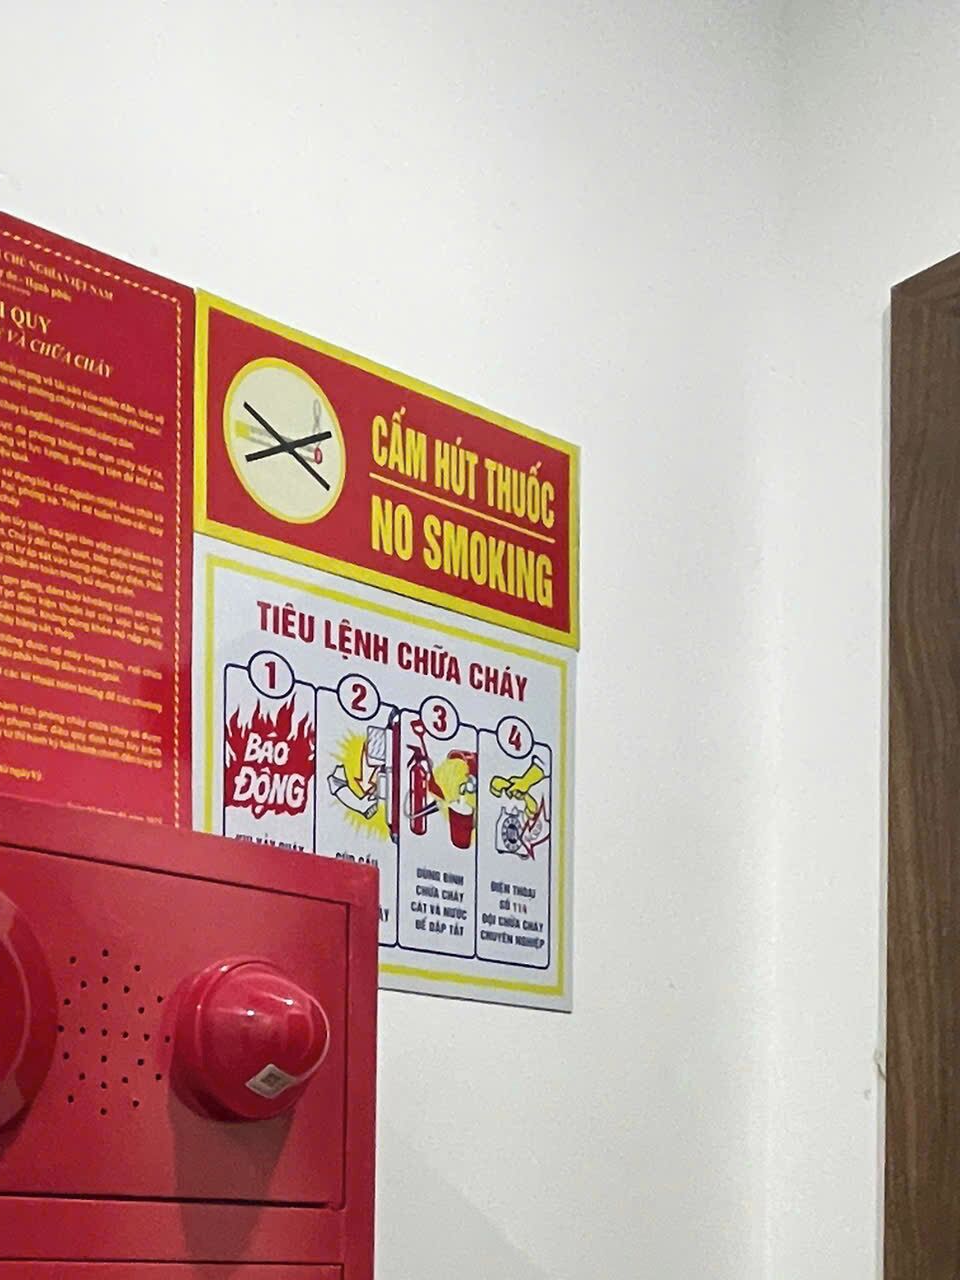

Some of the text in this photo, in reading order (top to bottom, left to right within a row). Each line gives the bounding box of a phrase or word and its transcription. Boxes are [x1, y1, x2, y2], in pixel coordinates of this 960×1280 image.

[10, 306, 51, 333] QUY
[7, 326, 25, 347] VÀ
[29, 339, 71, 363] CHỮA
[74, 354, 110, 377] CHÁY
[372, 406, 555, 528] CẤM HÚT THUỐC
[371, 495, 553, 608] NO SMOKING
[257, 600, 528, 701] TIÊU LỆNH CHỮA CHÁY
[264, 661, 276, 689] 1
[351, 683, 367, 712] 2
[433, 705, 447, 733] 3
[244, 729, 289, 765] BÁO
[508, 725, 522, 751] 4
[234, 762, 306, 816] ĐỘNG
